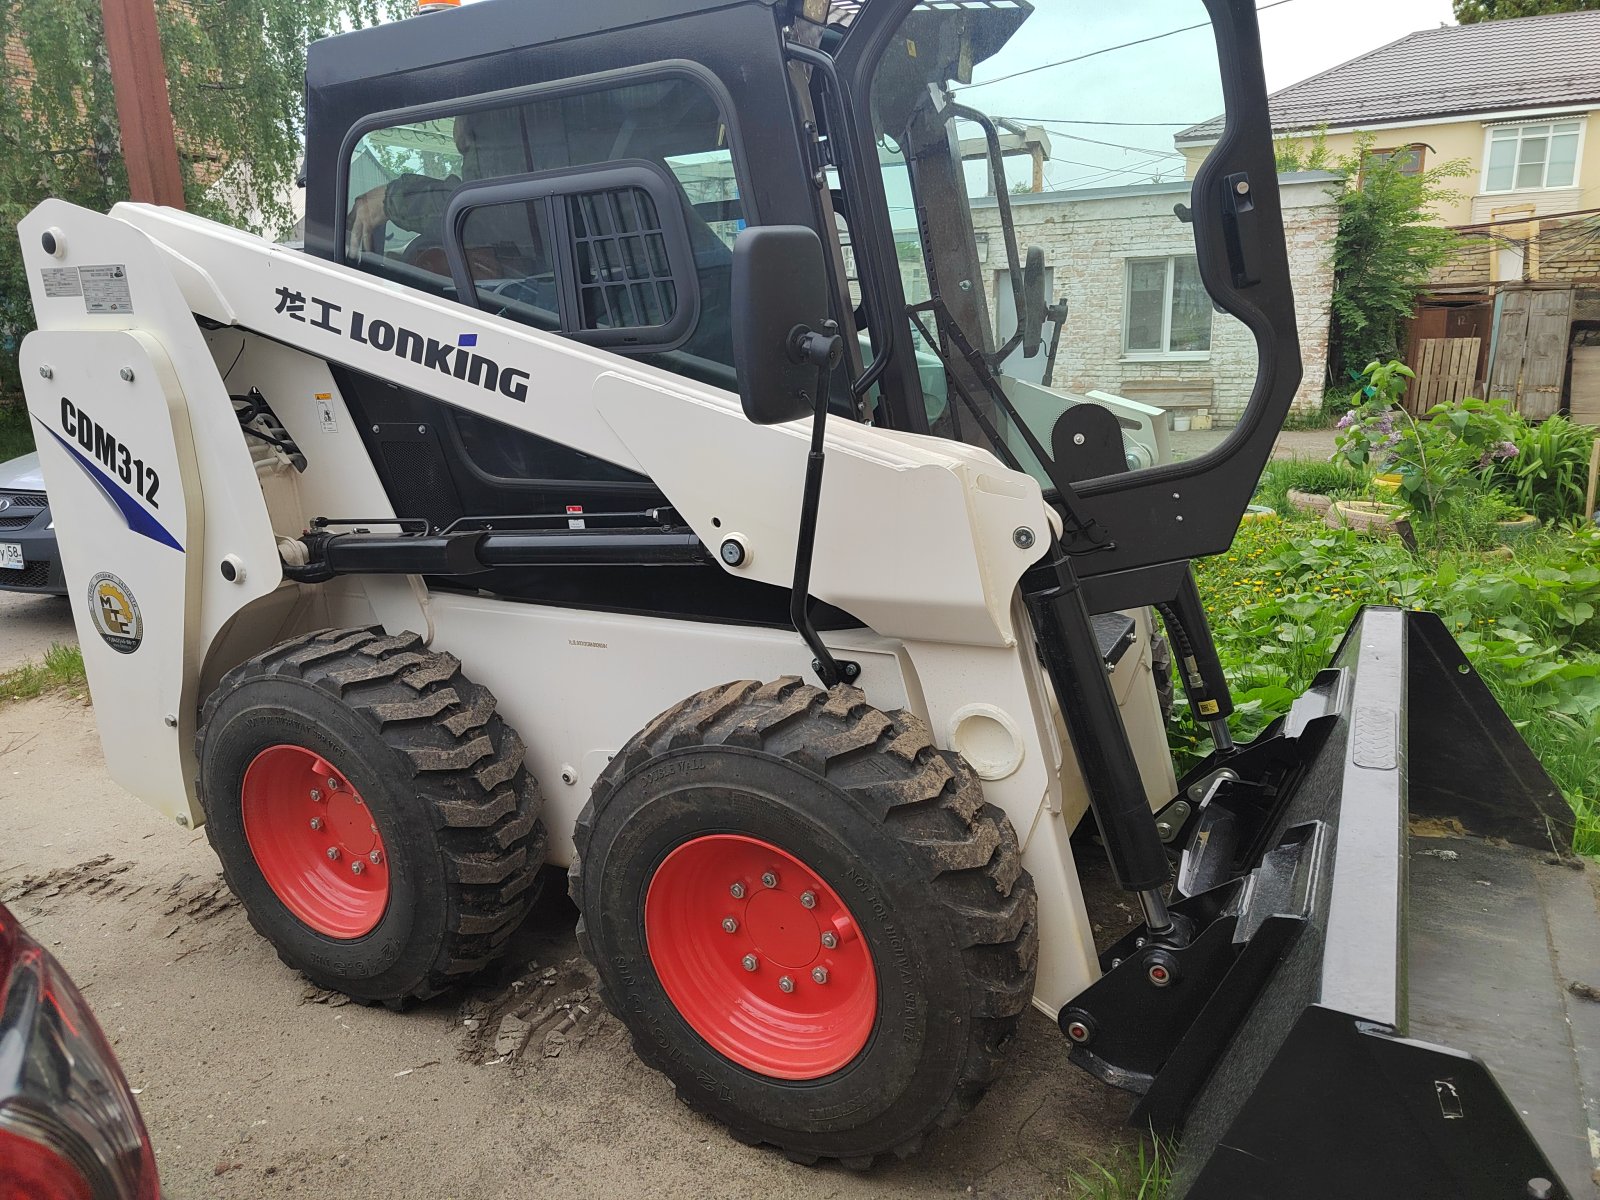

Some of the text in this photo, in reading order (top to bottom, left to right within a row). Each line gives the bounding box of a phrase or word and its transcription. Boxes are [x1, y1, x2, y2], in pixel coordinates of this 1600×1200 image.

[275, 286, 342, 336] 龙工
[60, 396, 160, 510] CDM312
[7, 545, 19, 558] 58
[846, 866, 918, 1045] NOT FOR HIGHWAY SERVICE
